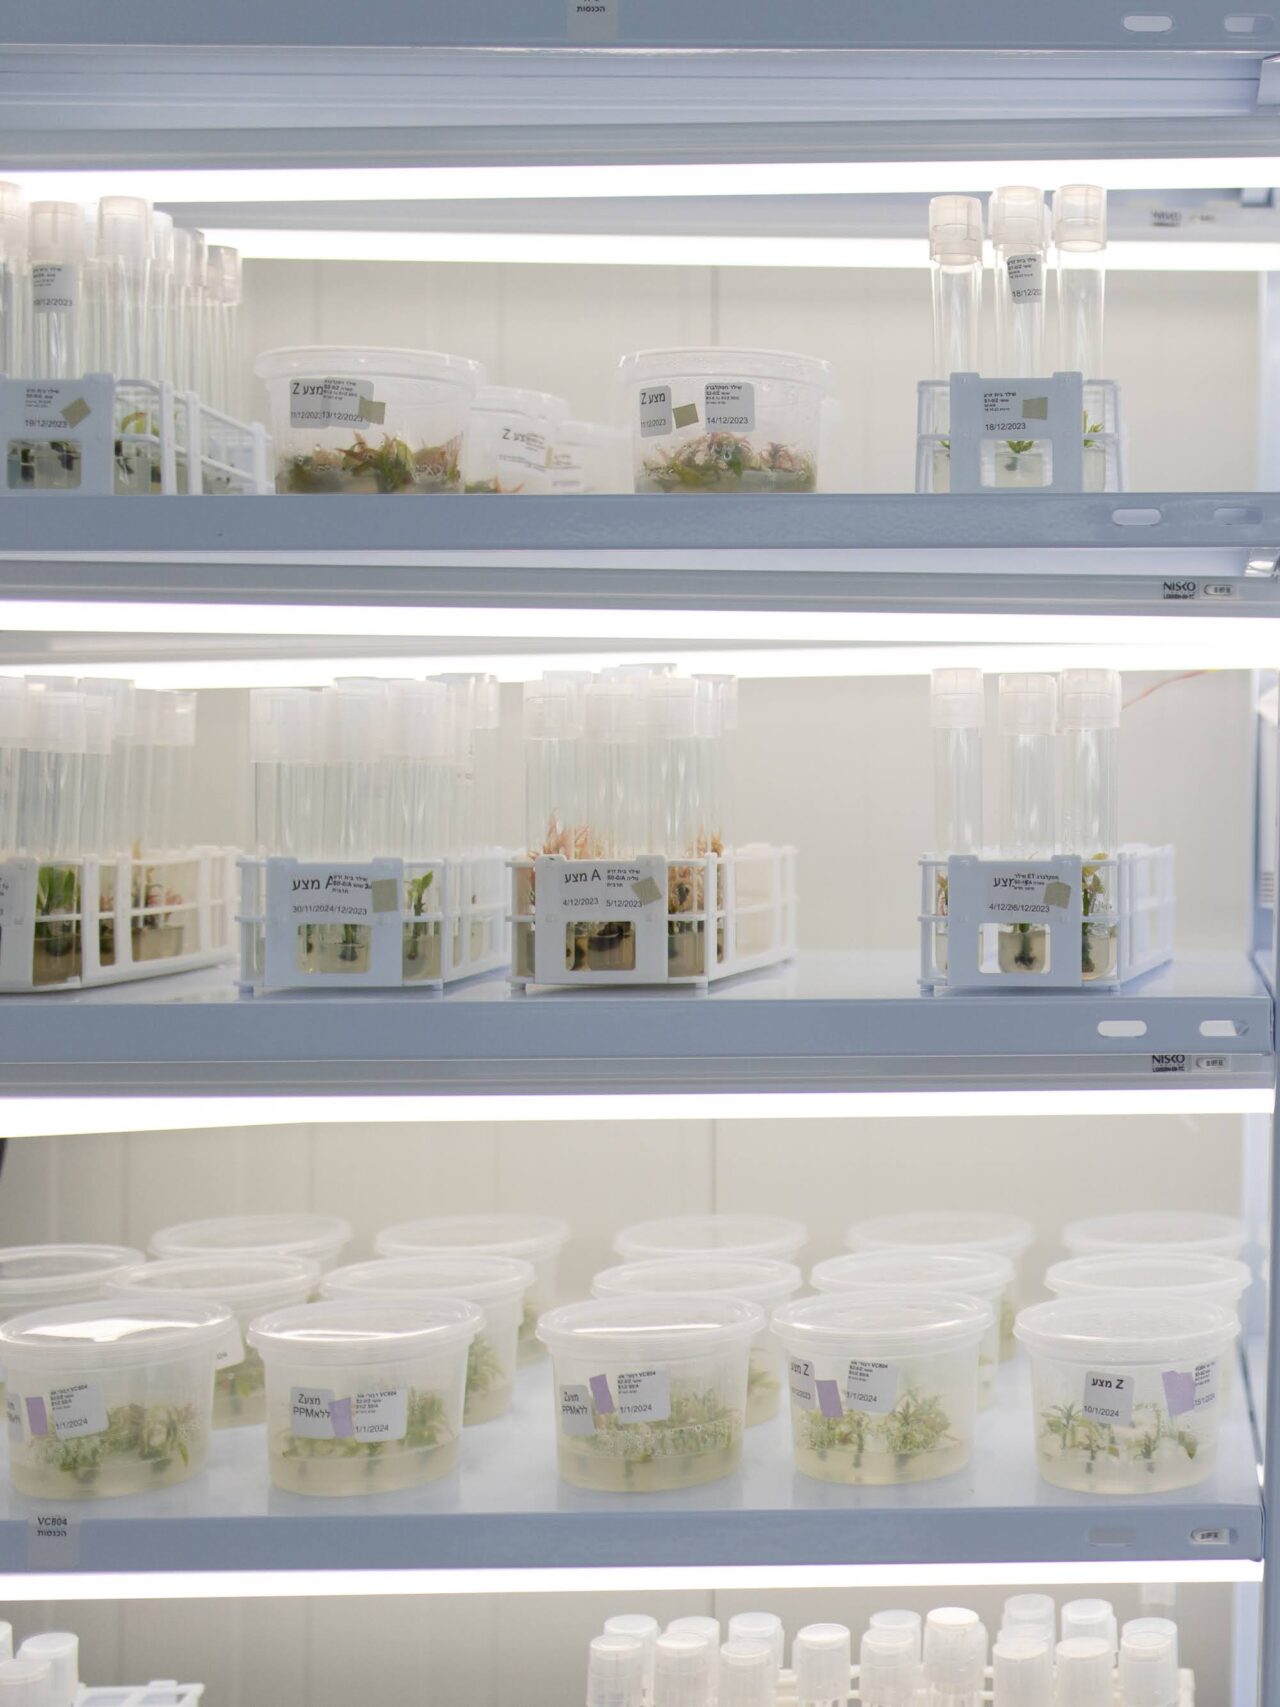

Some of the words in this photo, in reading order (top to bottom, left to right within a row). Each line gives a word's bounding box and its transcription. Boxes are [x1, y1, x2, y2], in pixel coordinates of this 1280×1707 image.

[292, 382, 300, 394] Z
[302, 384, 323, 395] מצע
[641, 393, 647, 404] Z
[648, 392, 666, 403] מצע
[707, 416, 749, 425] 14/12/2023
[985, 423, 1026, 431] 18/12/2023
[1163, 581, 1196, 592] NISKO
[563, 874, 586, 884] מצע
[590, 869, 601, 881] A
[292, 878, 320, 891] מצע
[325, 875, 333, 889] A
[562, 898, 598, 906] 4/12/2023
[606, 899, 641, 907] 5/12/2023
[1152, 1054, 1185, 1064] NISKO
[804, 1363, 810, 1377] Z
[1091, 1377, 1113, 1389] מצע
[1115, 1378, 1124, 1390] Z
[846, 1391, 877, 1402] 1/1/2024
[620, 1403, 652, 1414] 1/1/2024
[1084, 1405, 1120, 1418] 10/1/2024
[355, 1424, 389, 1433] 1/1/2024
